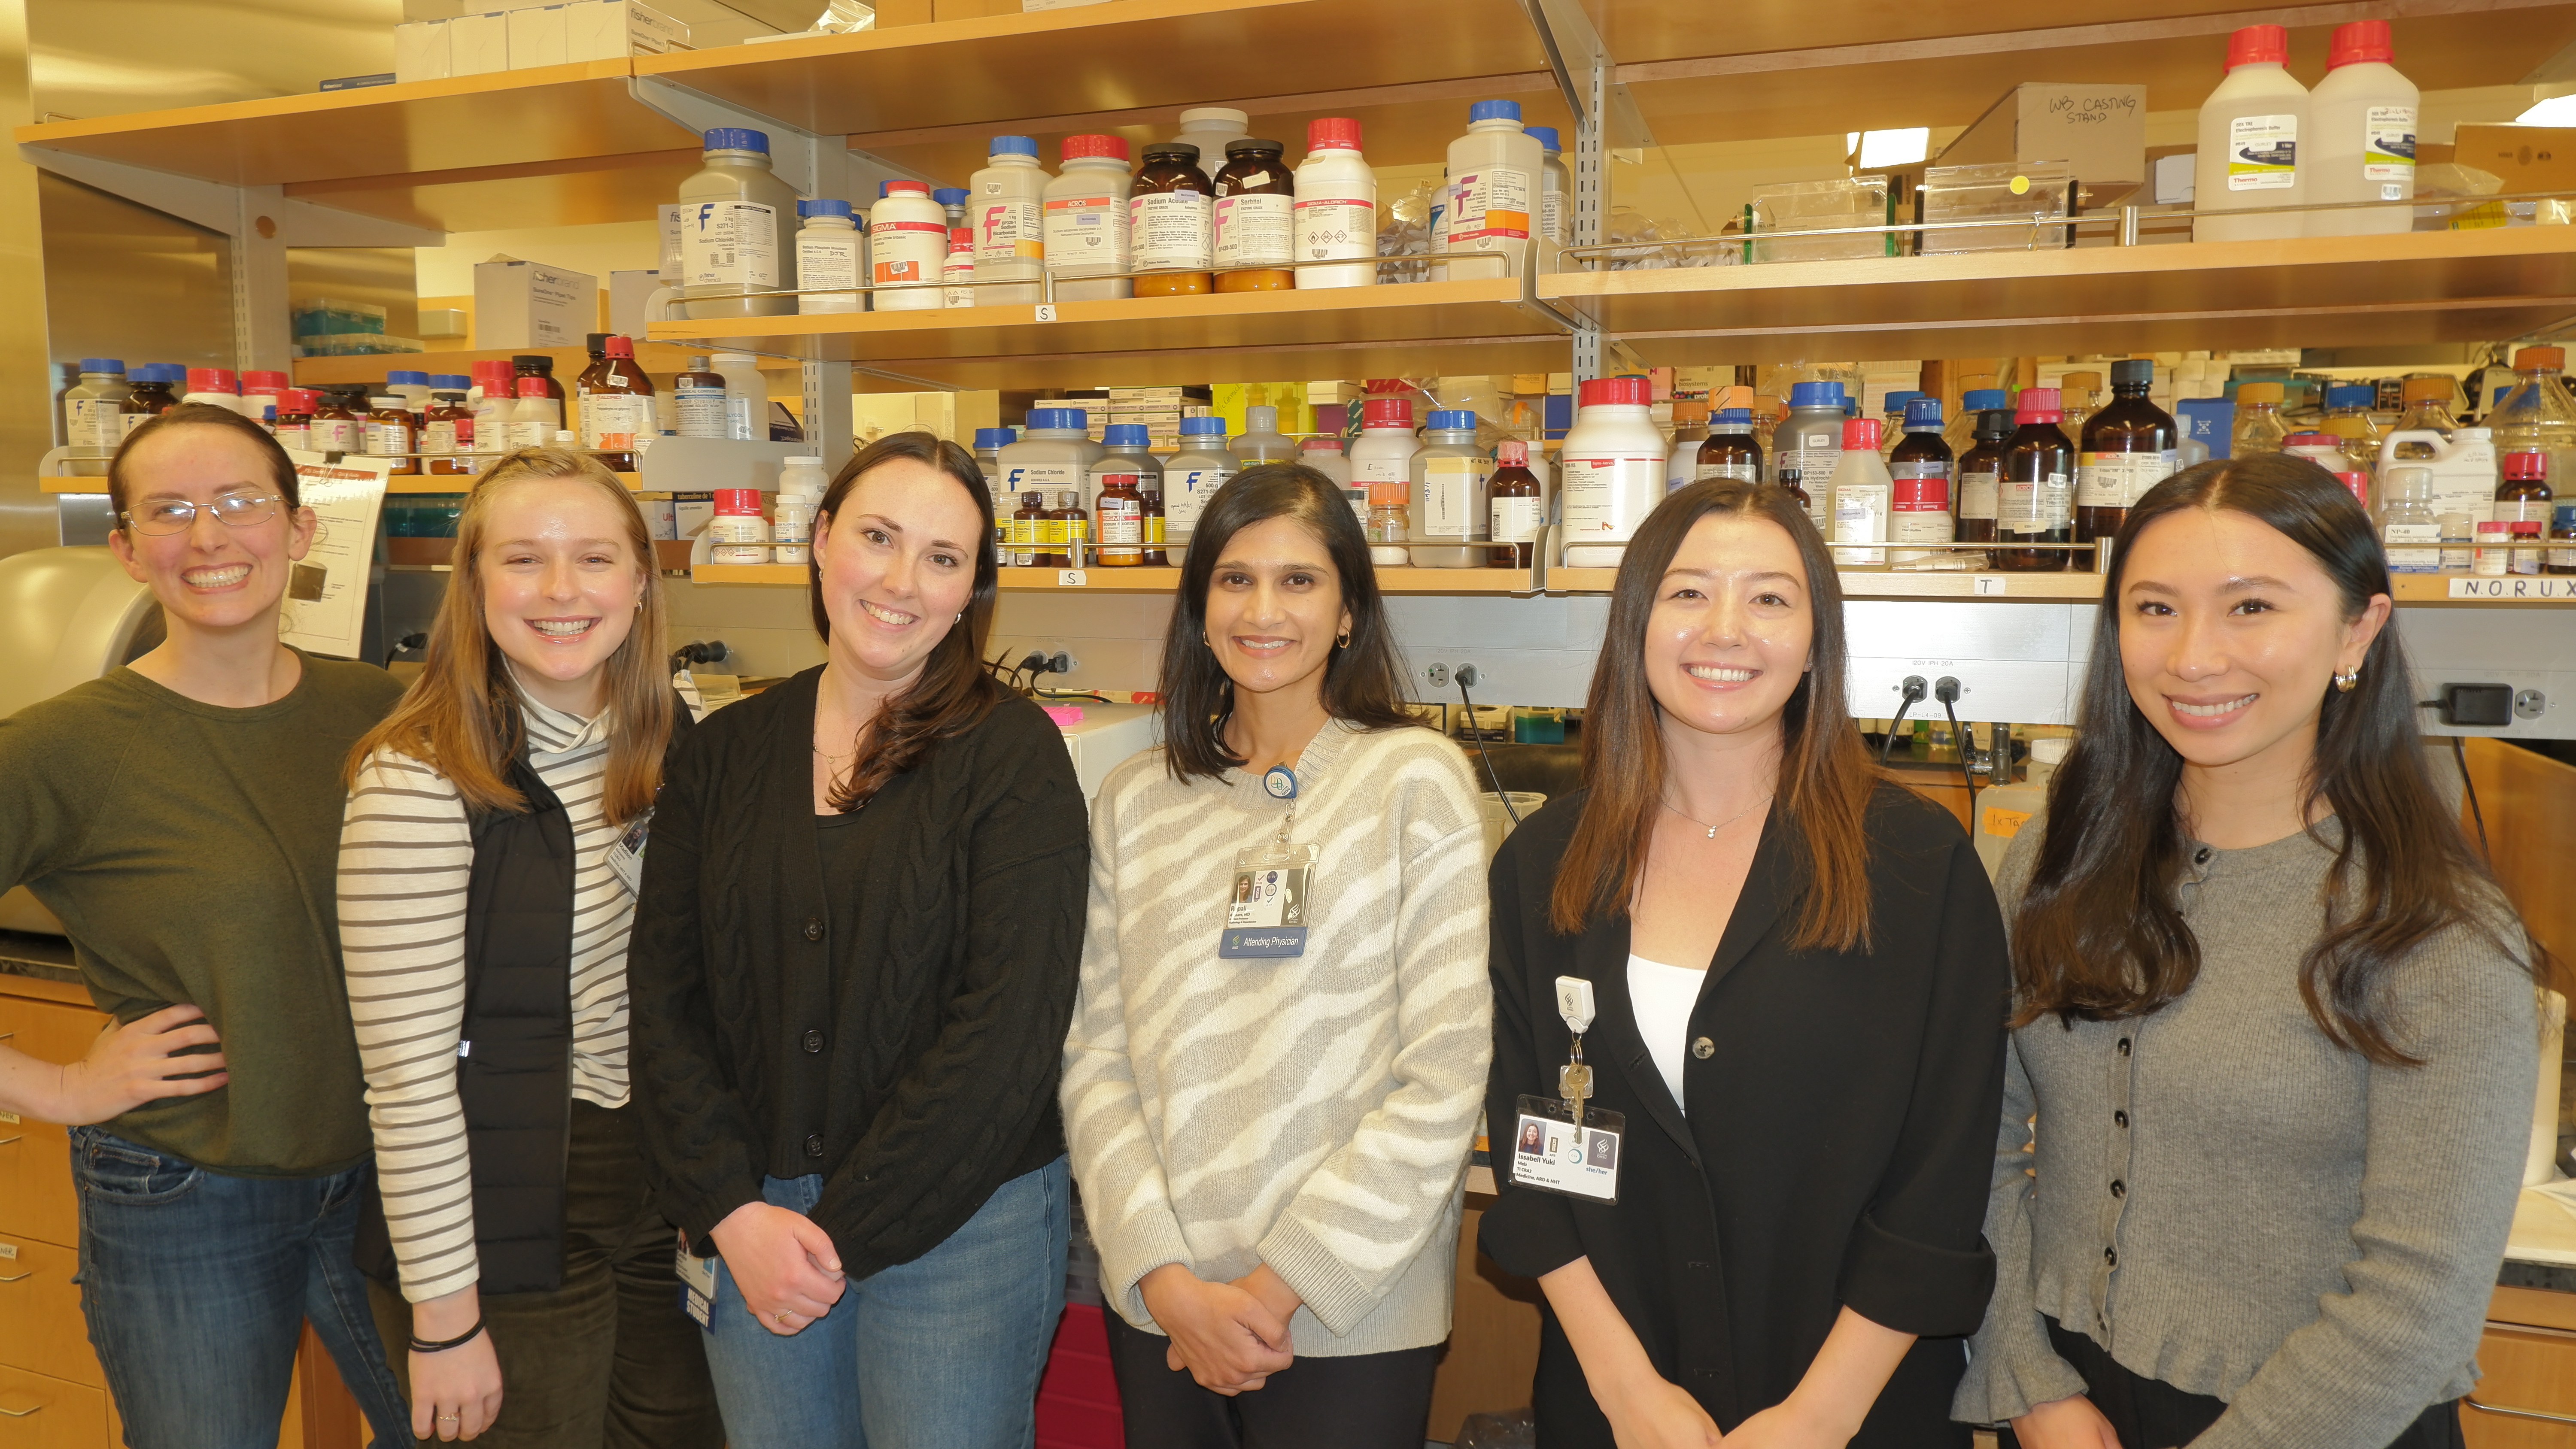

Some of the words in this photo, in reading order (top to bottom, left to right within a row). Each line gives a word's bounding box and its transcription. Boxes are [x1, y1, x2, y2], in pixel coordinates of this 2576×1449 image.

[631, 8, 673, 35] fisherbrand
[2050, 96, 2075, 113] WB
[2083, 95, 2136, 117] CASTING
[2067, 112, 2107, 124] STAND
[1040, 307, 1048, 320] S
[1353, 408, 1364, 419] QIAGEN
[1348, 422, 1358, 433] QIAGEN
[663, 513, 674, 521] Ult
[1067, 573, 1076, 585] S
[1981, 580, 1992, 594] T
[1282, 787, 1291, 796] OHSU
[618, 843, 632, 861] Madison
[1243, 937, 1270, 948] Attending
[1271, 936, 1298, 948] Physician
[1518, 1153, 1540, 1163] Issabell
[1516, 1172, 1535, 1181] Medicine,
[1586, 1166, 1608, 1175] she/her
[687, 1300, 709, 1328] STUDENT
